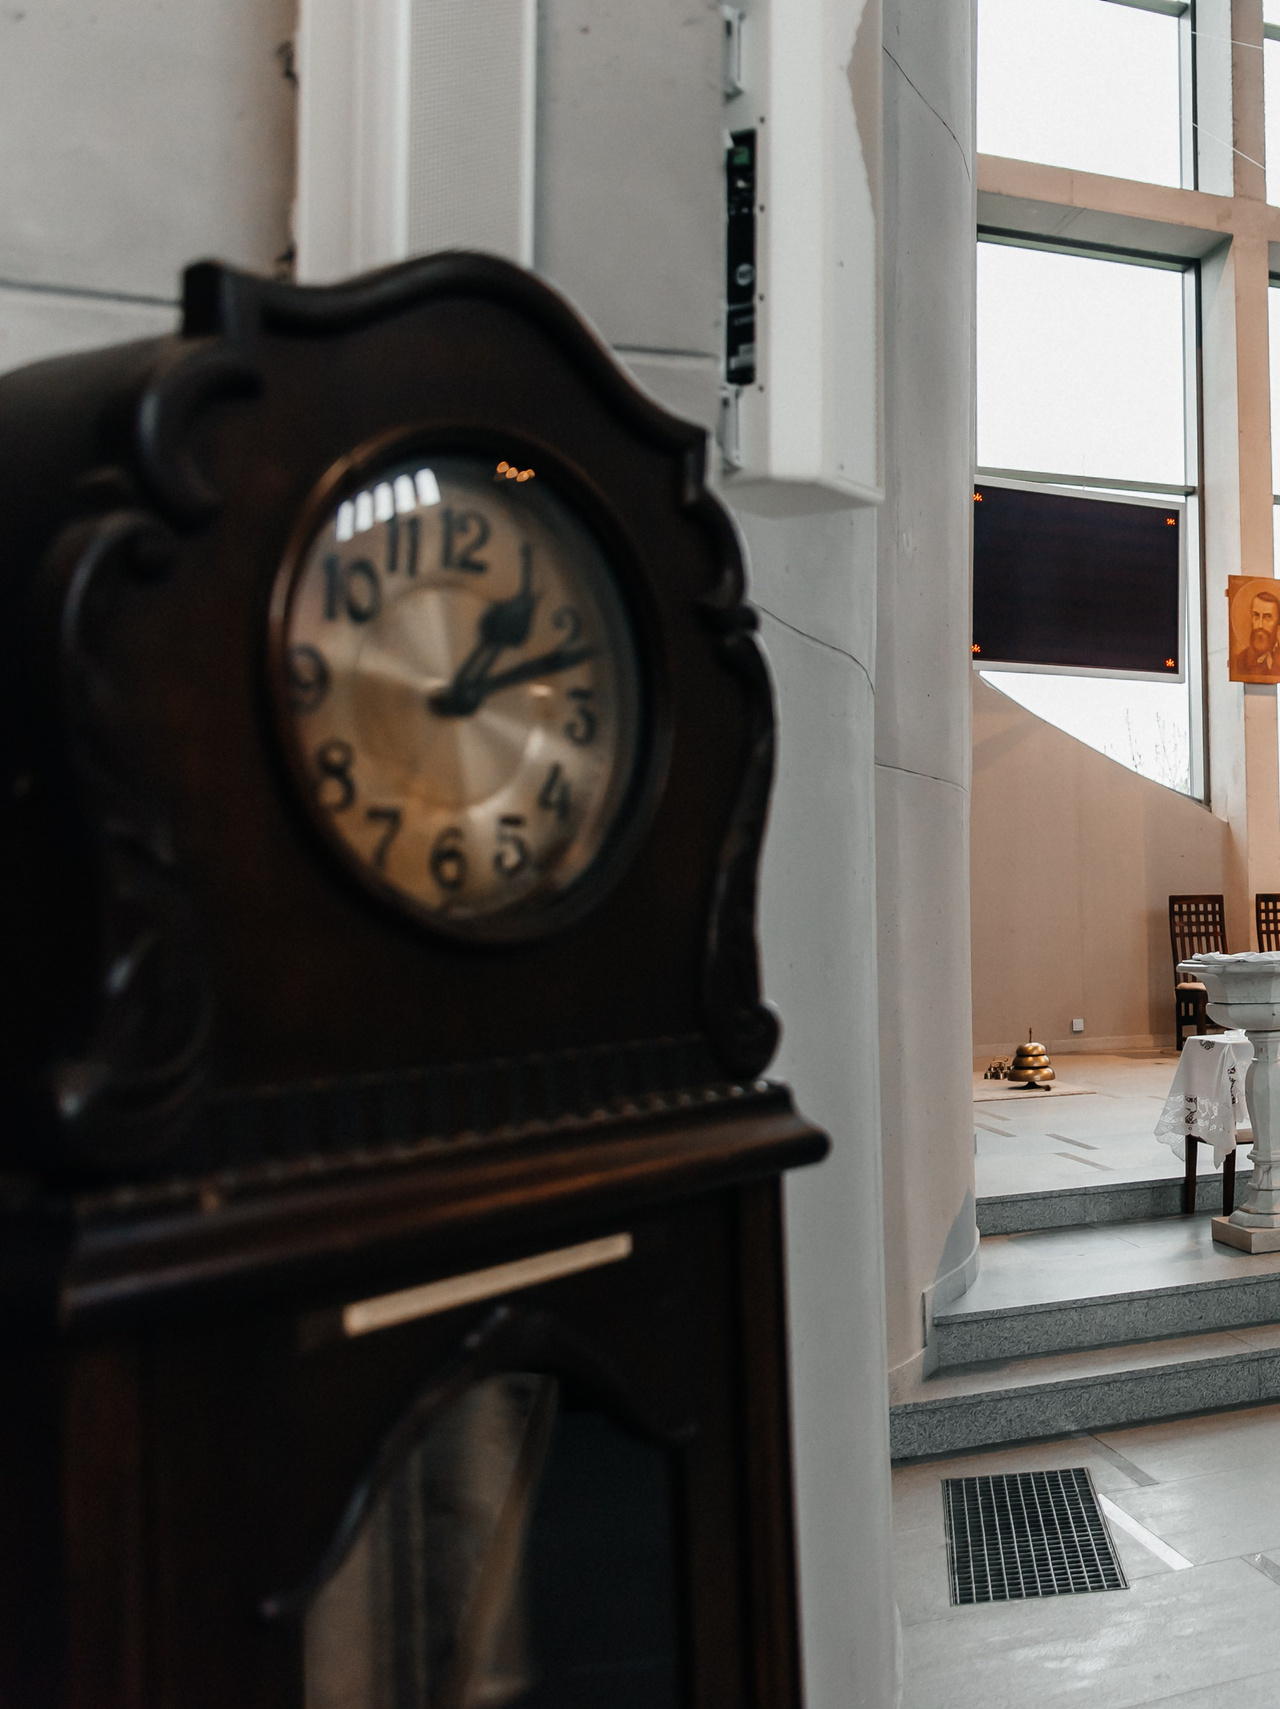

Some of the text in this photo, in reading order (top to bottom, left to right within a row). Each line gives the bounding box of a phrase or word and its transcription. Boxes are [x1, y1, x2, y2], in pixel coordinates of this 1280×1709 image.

[386, 510, 421, 577] 11
[441, 506, 493, 575] 12
[323, 553, 381, 624] 10
[289, 644, 330, 713] 9
[564, 688, 597, 746] 3
[317, 739, 355, 812] 8
[539, 763, 572, 823] 4
[366, 807, 400, 870] 7
[429, 826, 468, 890] 6
[494, 814, 530, 880] 5
